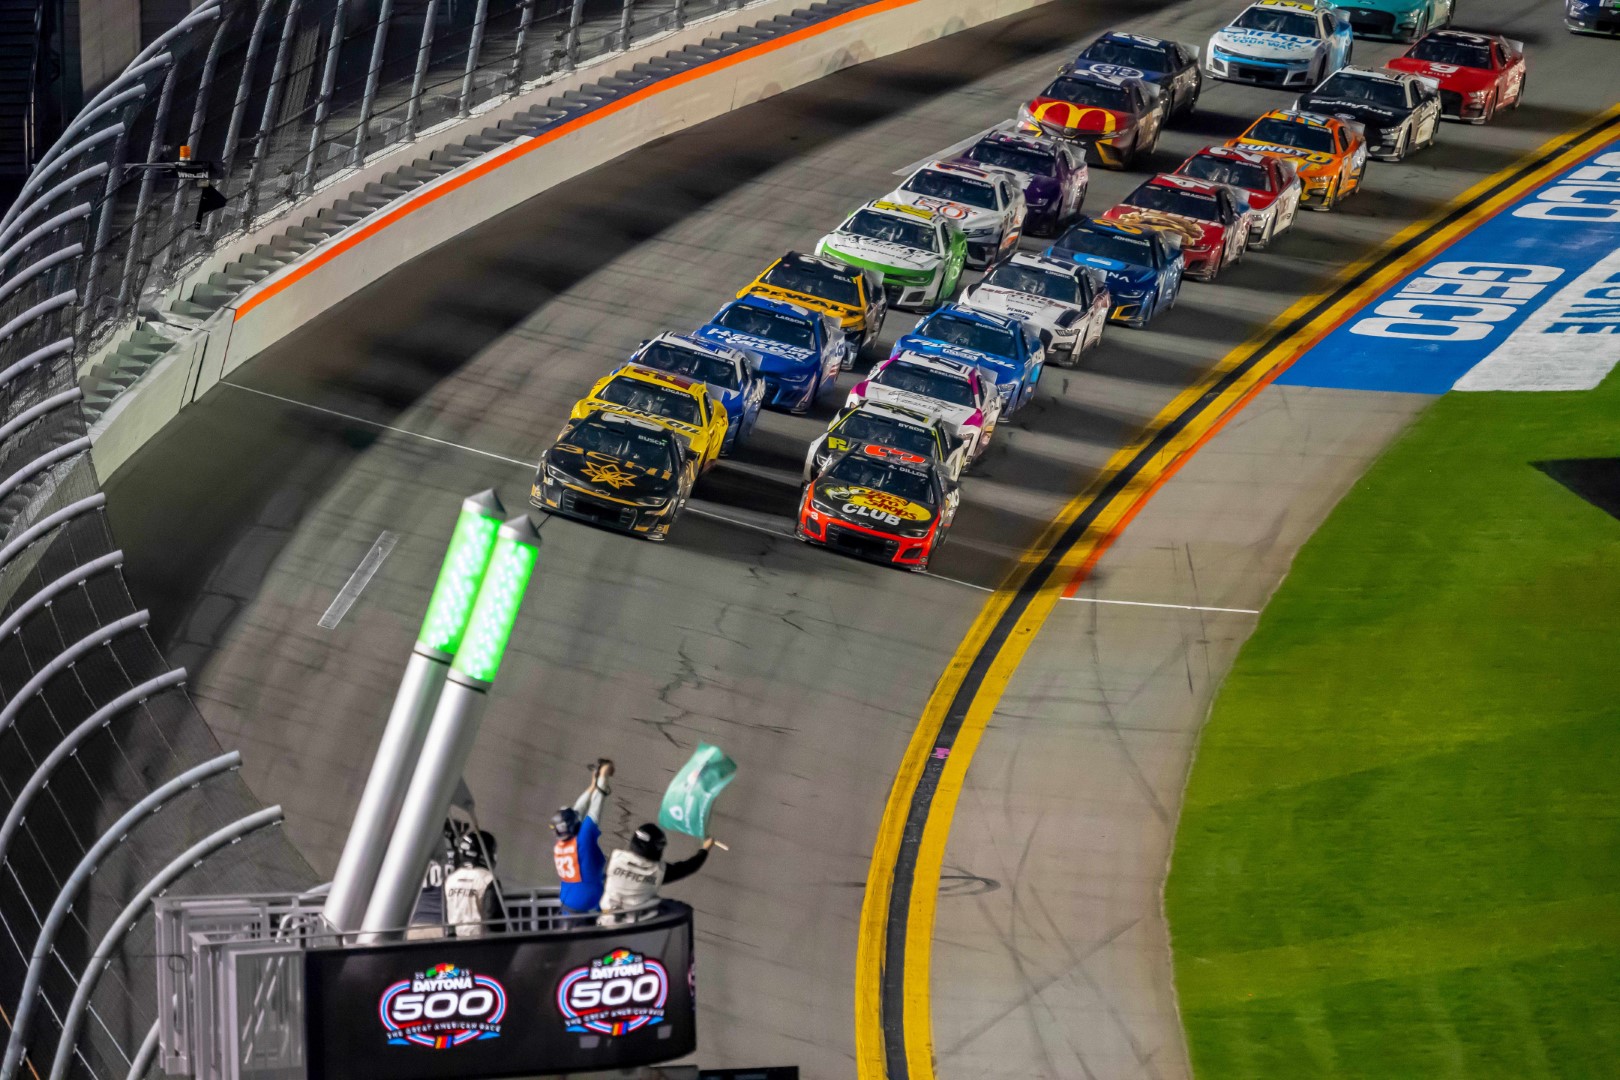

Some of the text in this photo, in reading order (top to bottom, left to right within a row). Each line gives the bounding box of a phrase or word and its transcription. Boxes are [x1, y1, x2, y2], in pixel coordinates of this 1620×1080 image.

[1349, 261, 1566, 342] GEICO
[775, 313, 805, 325] LARSON
[660, 386, 691, 398] LOGANO
[898, 422, 925, 433] BYRON
[637, 434, 666, 446] BUSCH
[841, 503, 901, 526] CLUB
[590, 962, 645, 980] DAYTONA
[412, 977, 473, 992] DAYTONA
[570, 974, 660, 1009] 500
[391, 989, 494, 1021] 500
